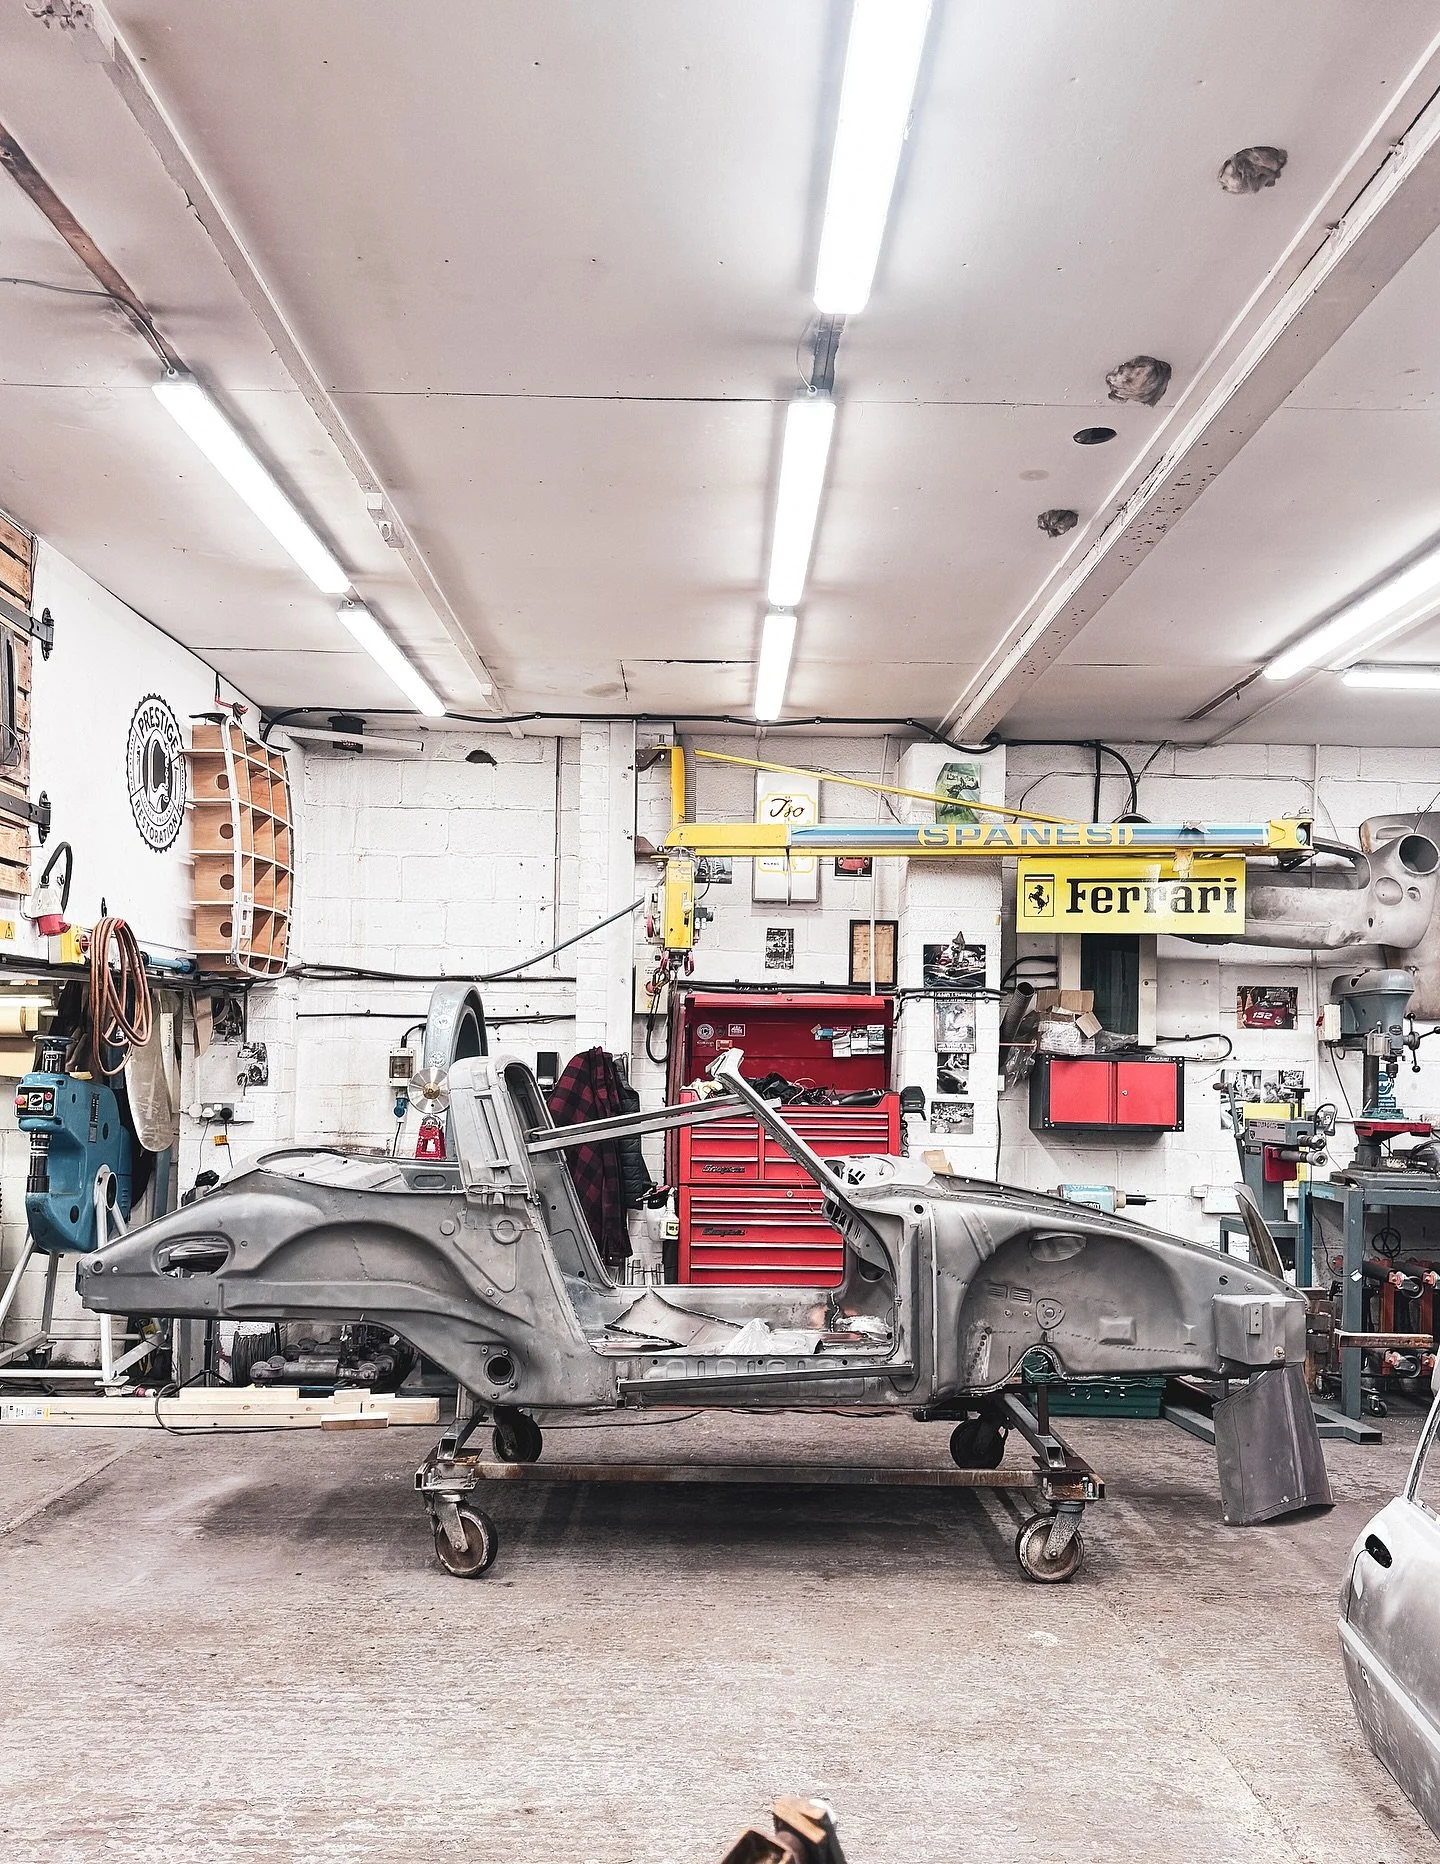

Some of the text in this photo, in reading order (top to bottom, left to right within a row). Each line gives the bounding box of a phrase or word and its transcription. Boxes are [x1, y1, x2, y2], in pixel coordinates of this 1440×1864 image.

[138, 706, 179, 754] PRESTIGE
[134, 799, 178, 844] RESTORATION
[923, 824, 1126, 846] SPANESI
[1066, 878, 1237, 914] Ferrari
